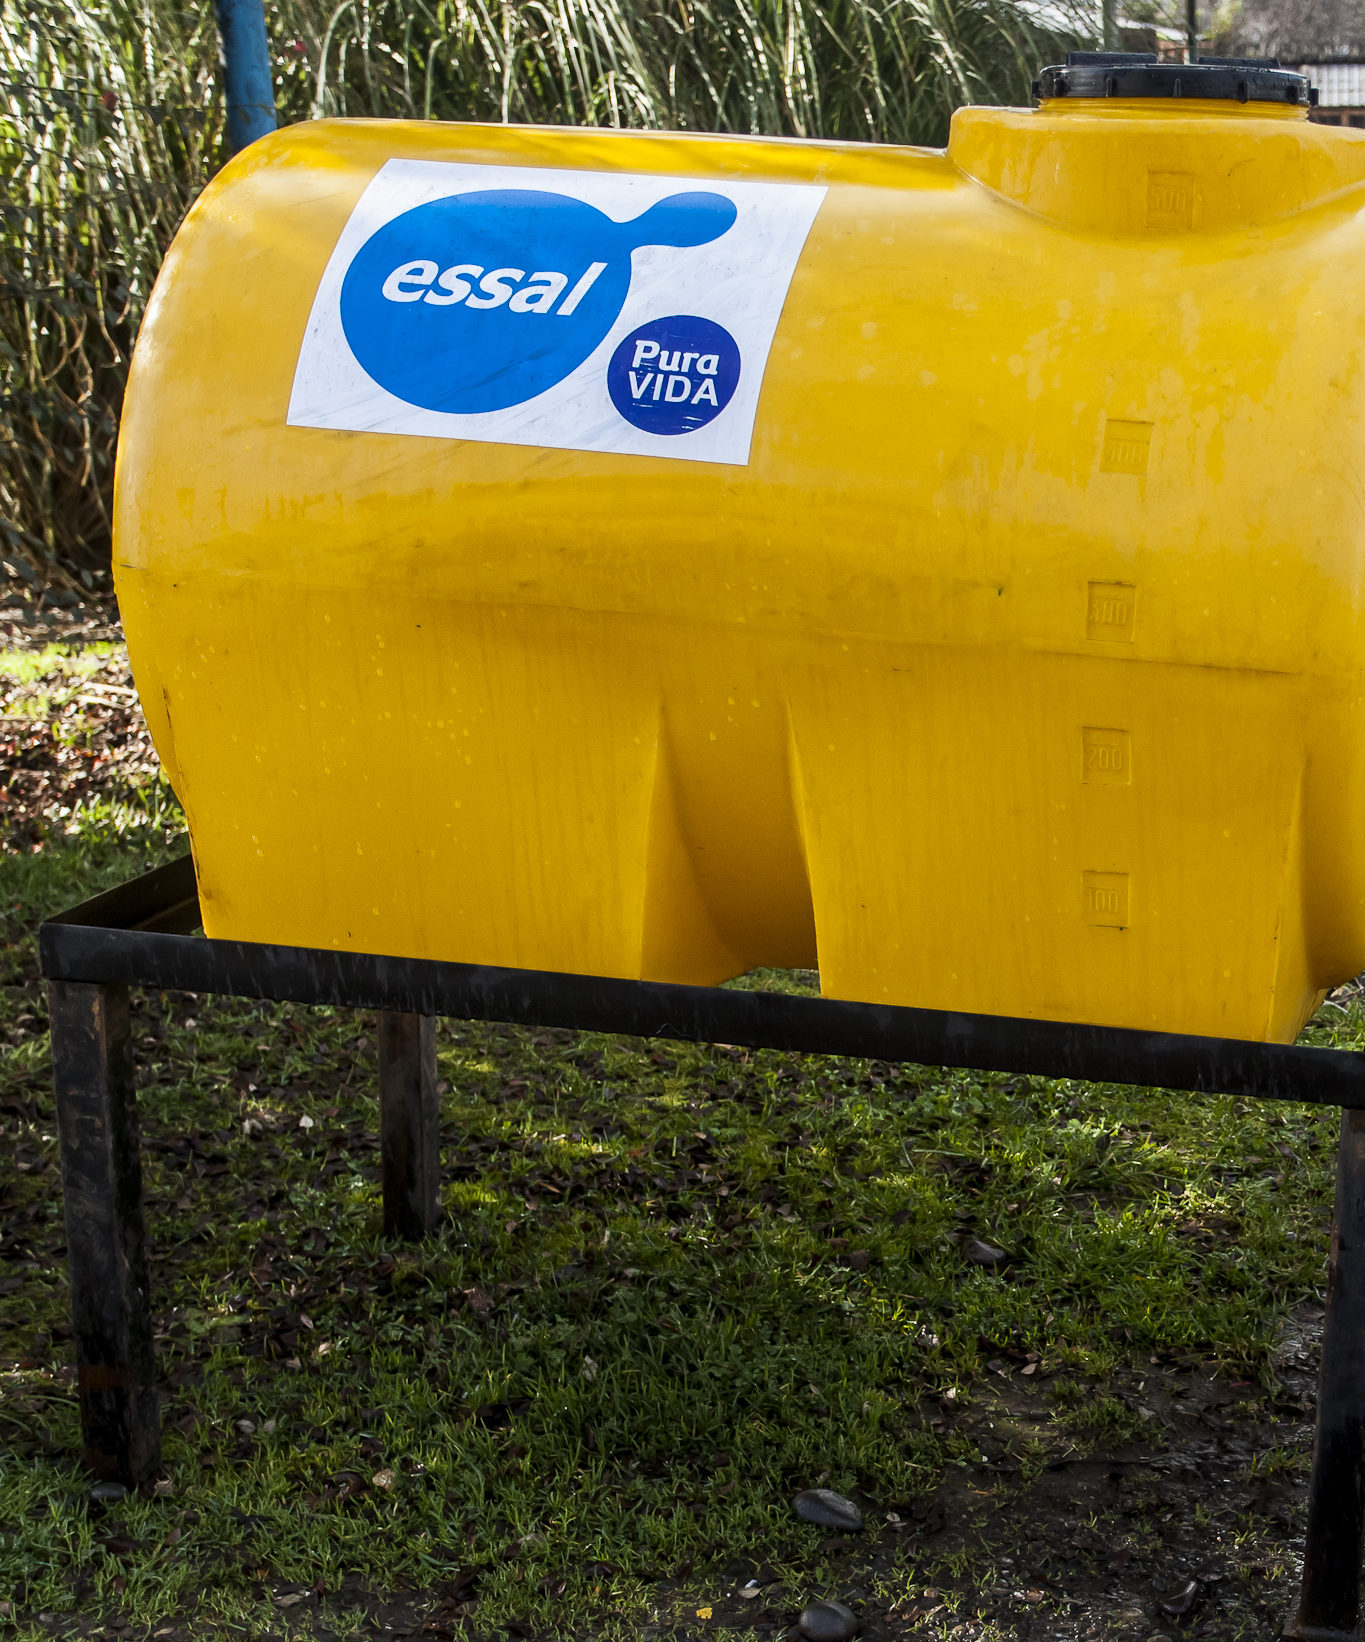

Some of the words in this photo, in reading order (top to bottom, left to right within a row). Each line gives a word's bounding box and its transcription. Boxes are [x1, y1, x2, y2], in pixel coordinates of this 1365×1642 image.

[381, 260, 608, 316] essal
[632, 339, 720, 376] Pura
[628, 371, 720, 407] VIDA
[1086, 746, 1122, 770] 200
[1085, 888, 1118, 912] 100
